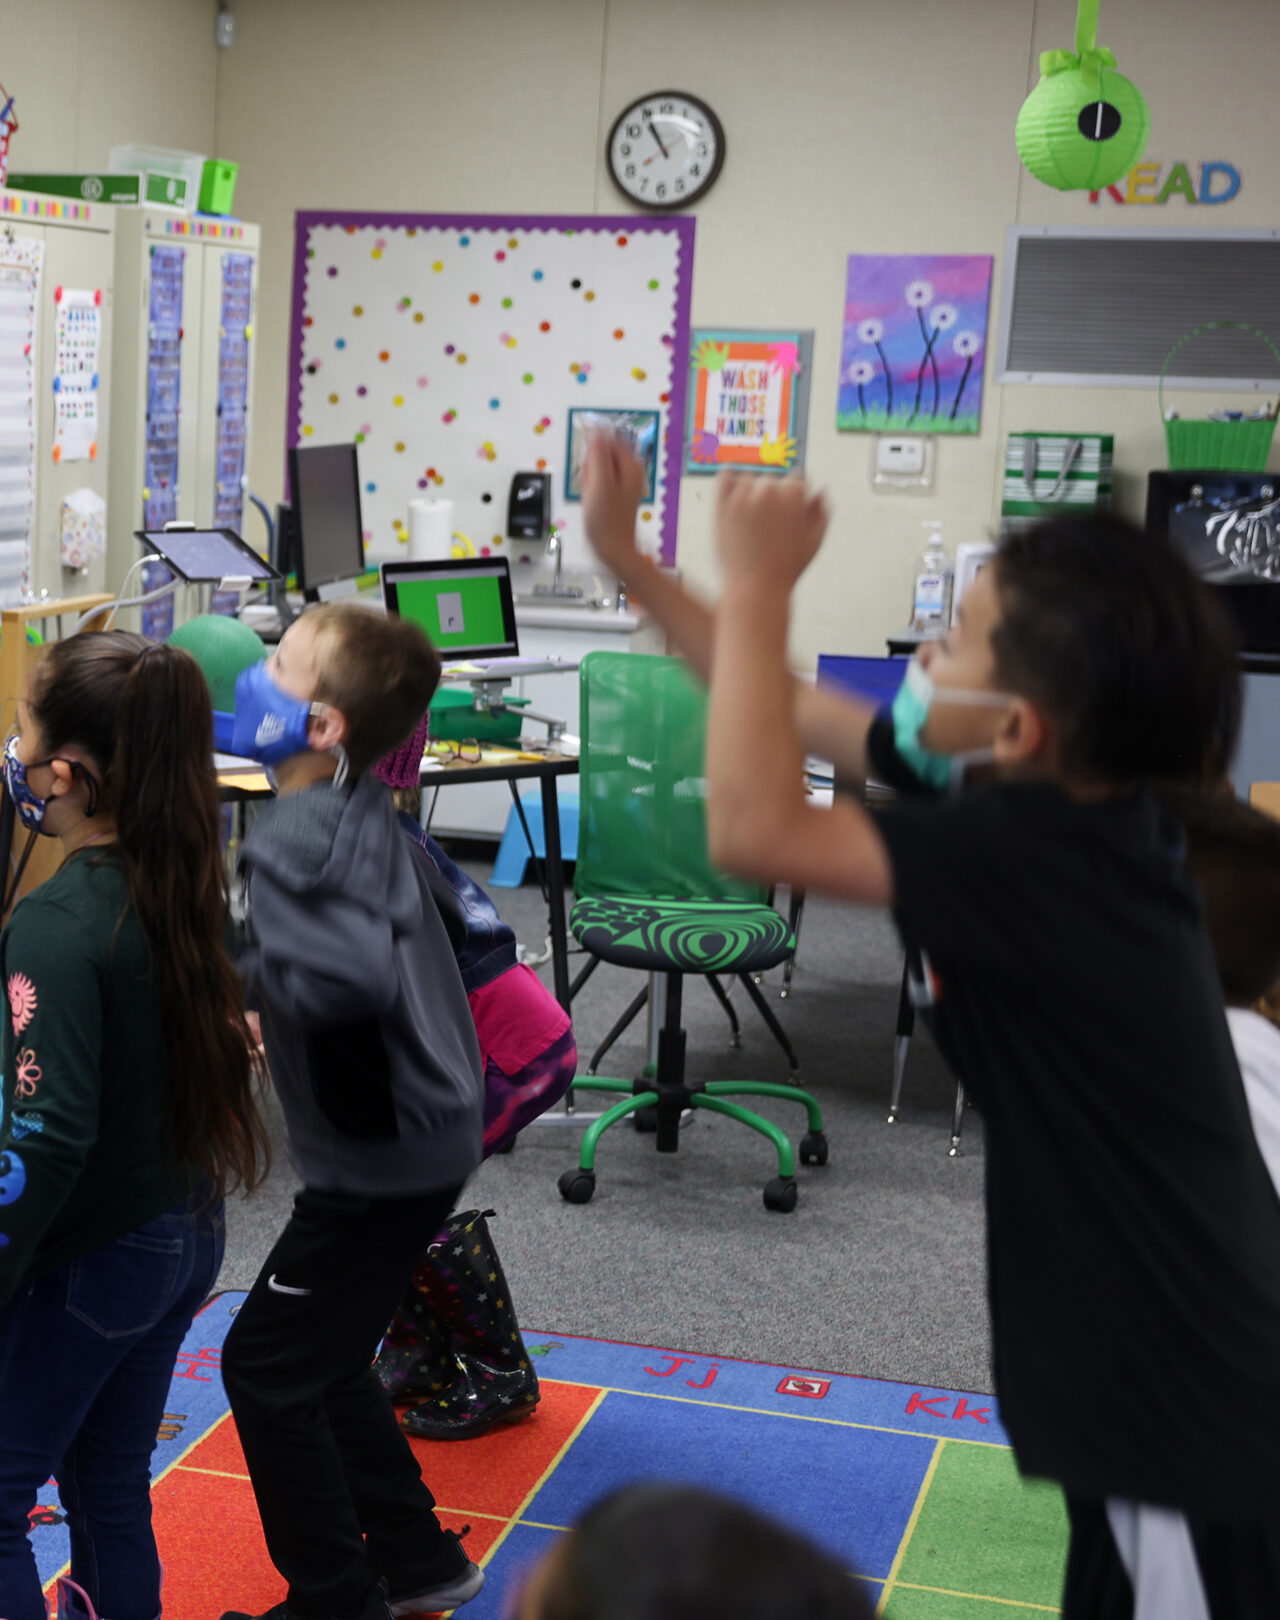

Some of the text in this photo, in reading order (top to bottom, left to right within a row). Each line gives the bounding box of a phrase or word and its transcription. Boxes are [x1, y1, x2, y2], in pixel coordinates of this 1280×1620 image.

[626, 123, 642, 140] 10
[689, 162, 700, 177] 4
[640, 176, 649, 193] 7
[656, 181, 667, 198] 6
[674, 176, 685, 194] 5
[721, 368, 769, 391] WASH
[719, 393, 767, 416] THOSE
[716, 417, 765, 438] HANDS
[643, 1355, 720, 1390] Jj
[905, 1392, 993, 1425] Kk
